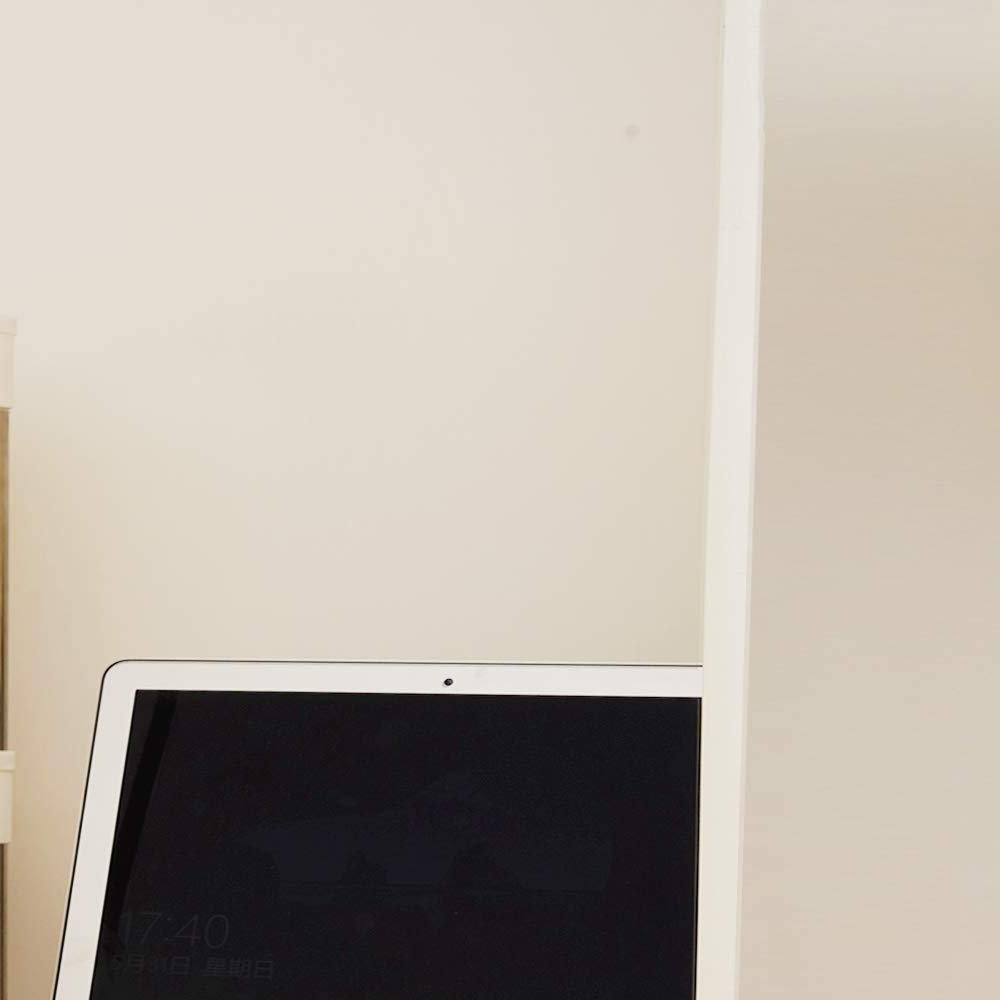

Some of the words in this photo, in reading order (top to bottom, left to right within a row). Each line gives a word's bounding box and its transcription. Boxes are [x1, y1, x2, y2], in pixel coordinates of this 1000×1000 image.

[120, 911, 230, 949] 17:40
[202, 956, 273, 980] 星期日
